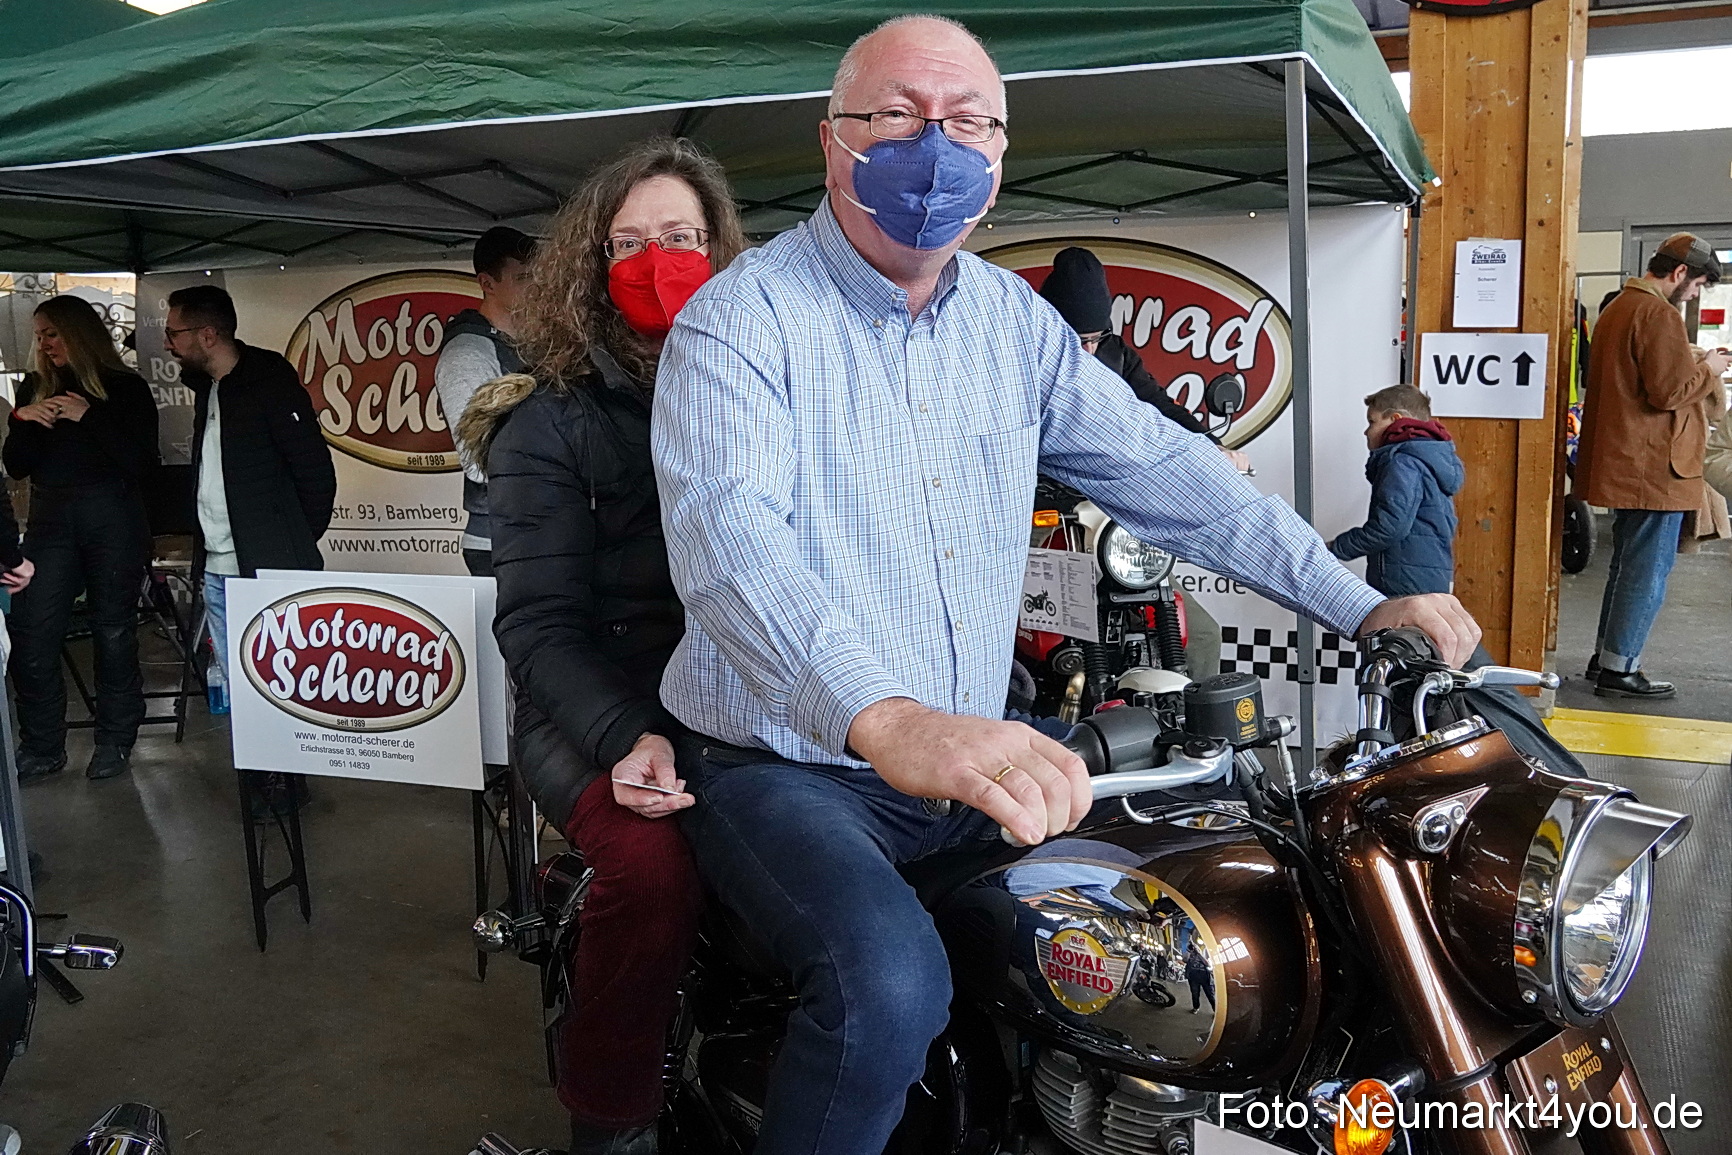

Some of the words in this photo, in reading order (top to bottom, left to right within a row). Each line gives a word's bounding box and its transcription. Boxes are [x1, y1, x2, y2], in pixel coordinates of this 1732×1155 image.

[303, 298, 454, 385] Moto
[150, 357, 182, 383] RO
[1432, 354, 1501, 386] WC
[407, 455, 423, 466] seit
[424, 455, 446, 466] 1989
[357, 504, 381, 522] 93,
[385, 504, 463, 524] Bamberg,
[256, 601, 451, 671] Motorrad
[268, 647, 440, 709] Scherer
[336, 718, 349, 727] seit
[350, 719, 366, 728] 1989
[300, 744, 344, 755] Erlichstrasse
[358, 749, 381, 758] 96050
[382, 751, 415, 762] Bamberg
[329, 759, 346, 768] 0951
[348, 761, 371, 770] 14839
[1051, 942, 1106, 973] ROYAL
[1047, 961, 1114, 994] ENFIELD
[1561, 1041, 1594, 1071] ROYAL
[1566, 1055, 1602, 1091] ENFIELD
